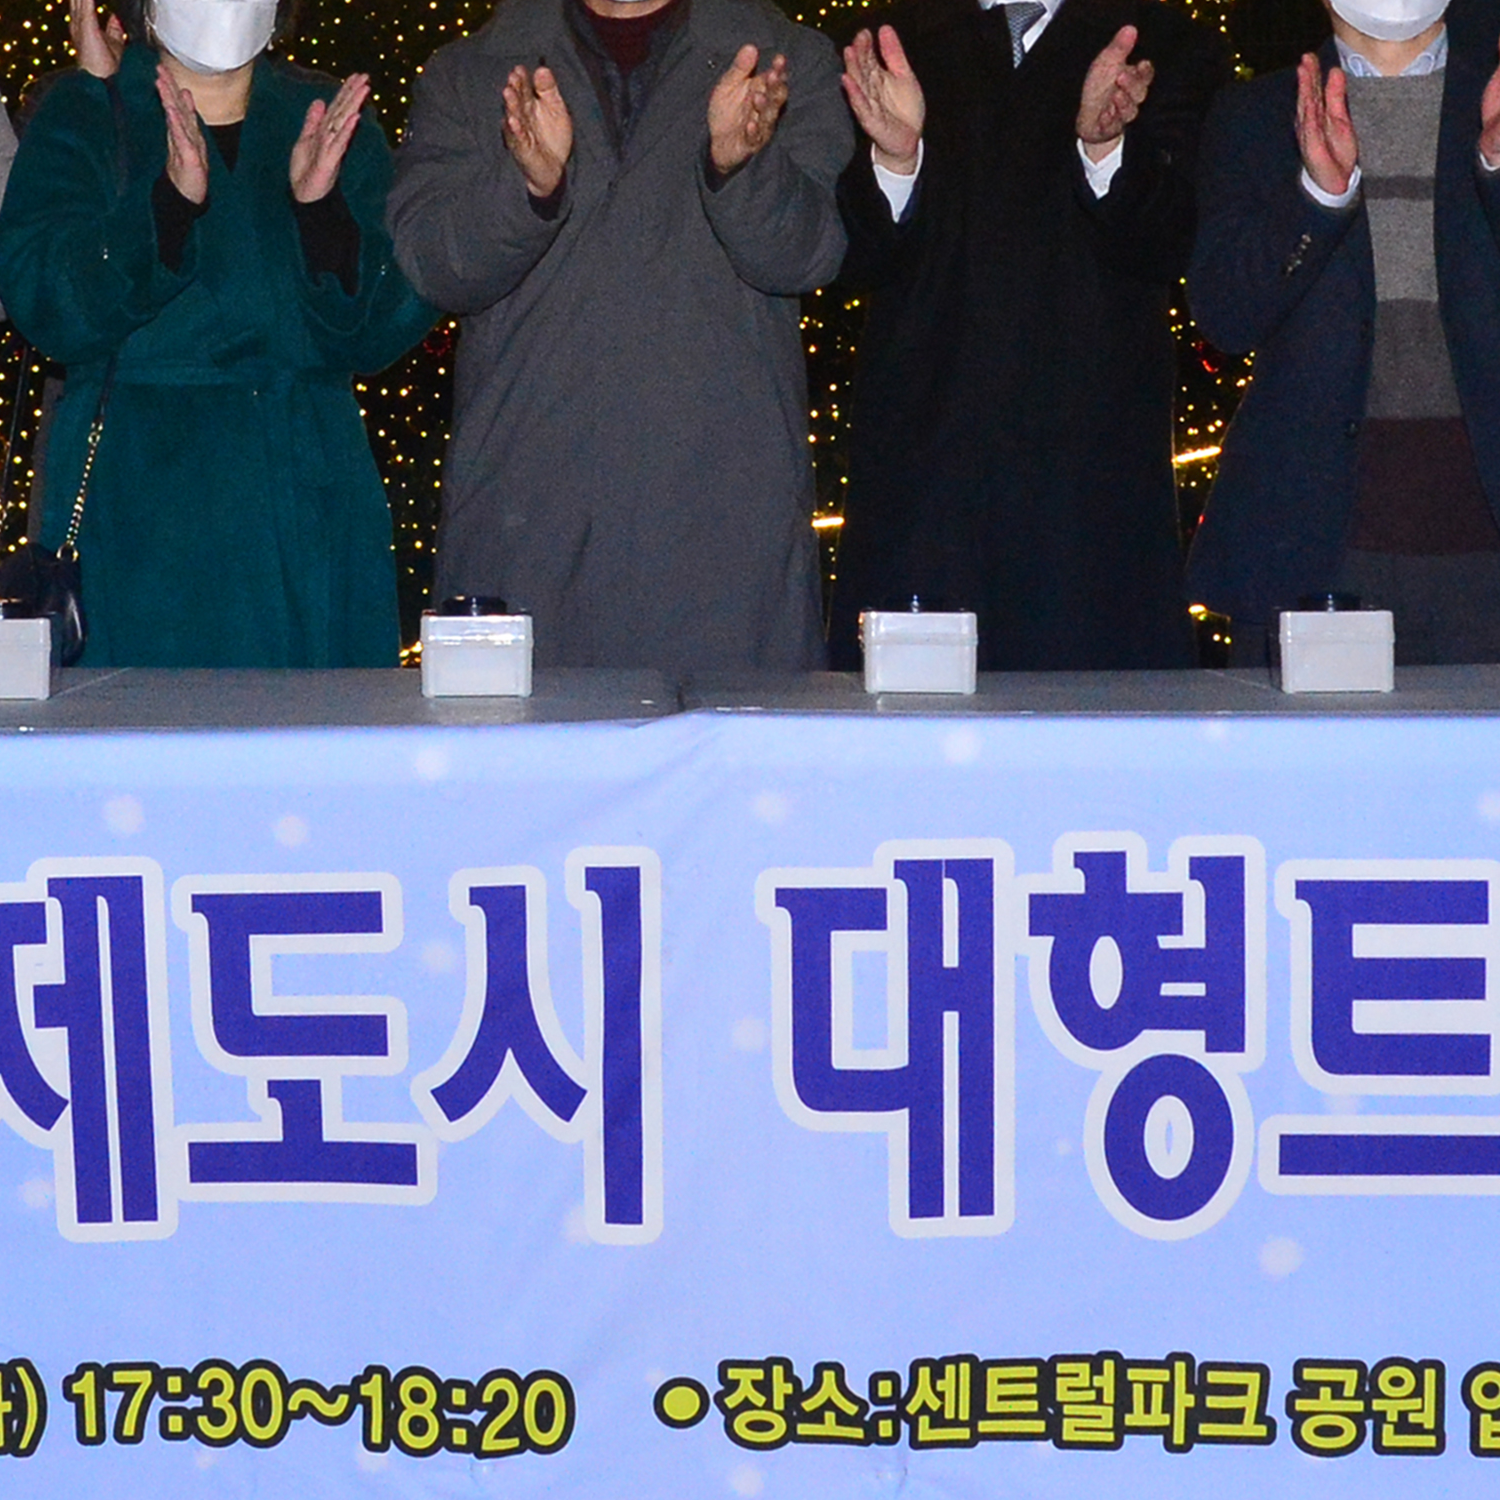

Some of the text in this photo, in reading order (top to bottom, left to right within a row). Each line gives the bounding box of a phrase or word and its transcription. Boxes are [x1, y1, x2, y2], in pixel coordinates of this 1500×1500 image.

[68, 1362, 571, 1455] 17:30~18:20
[720, 1355, 1272, 1449] 장소:센트럴파크
[1290, 1362, 1442, 1453] 공원
